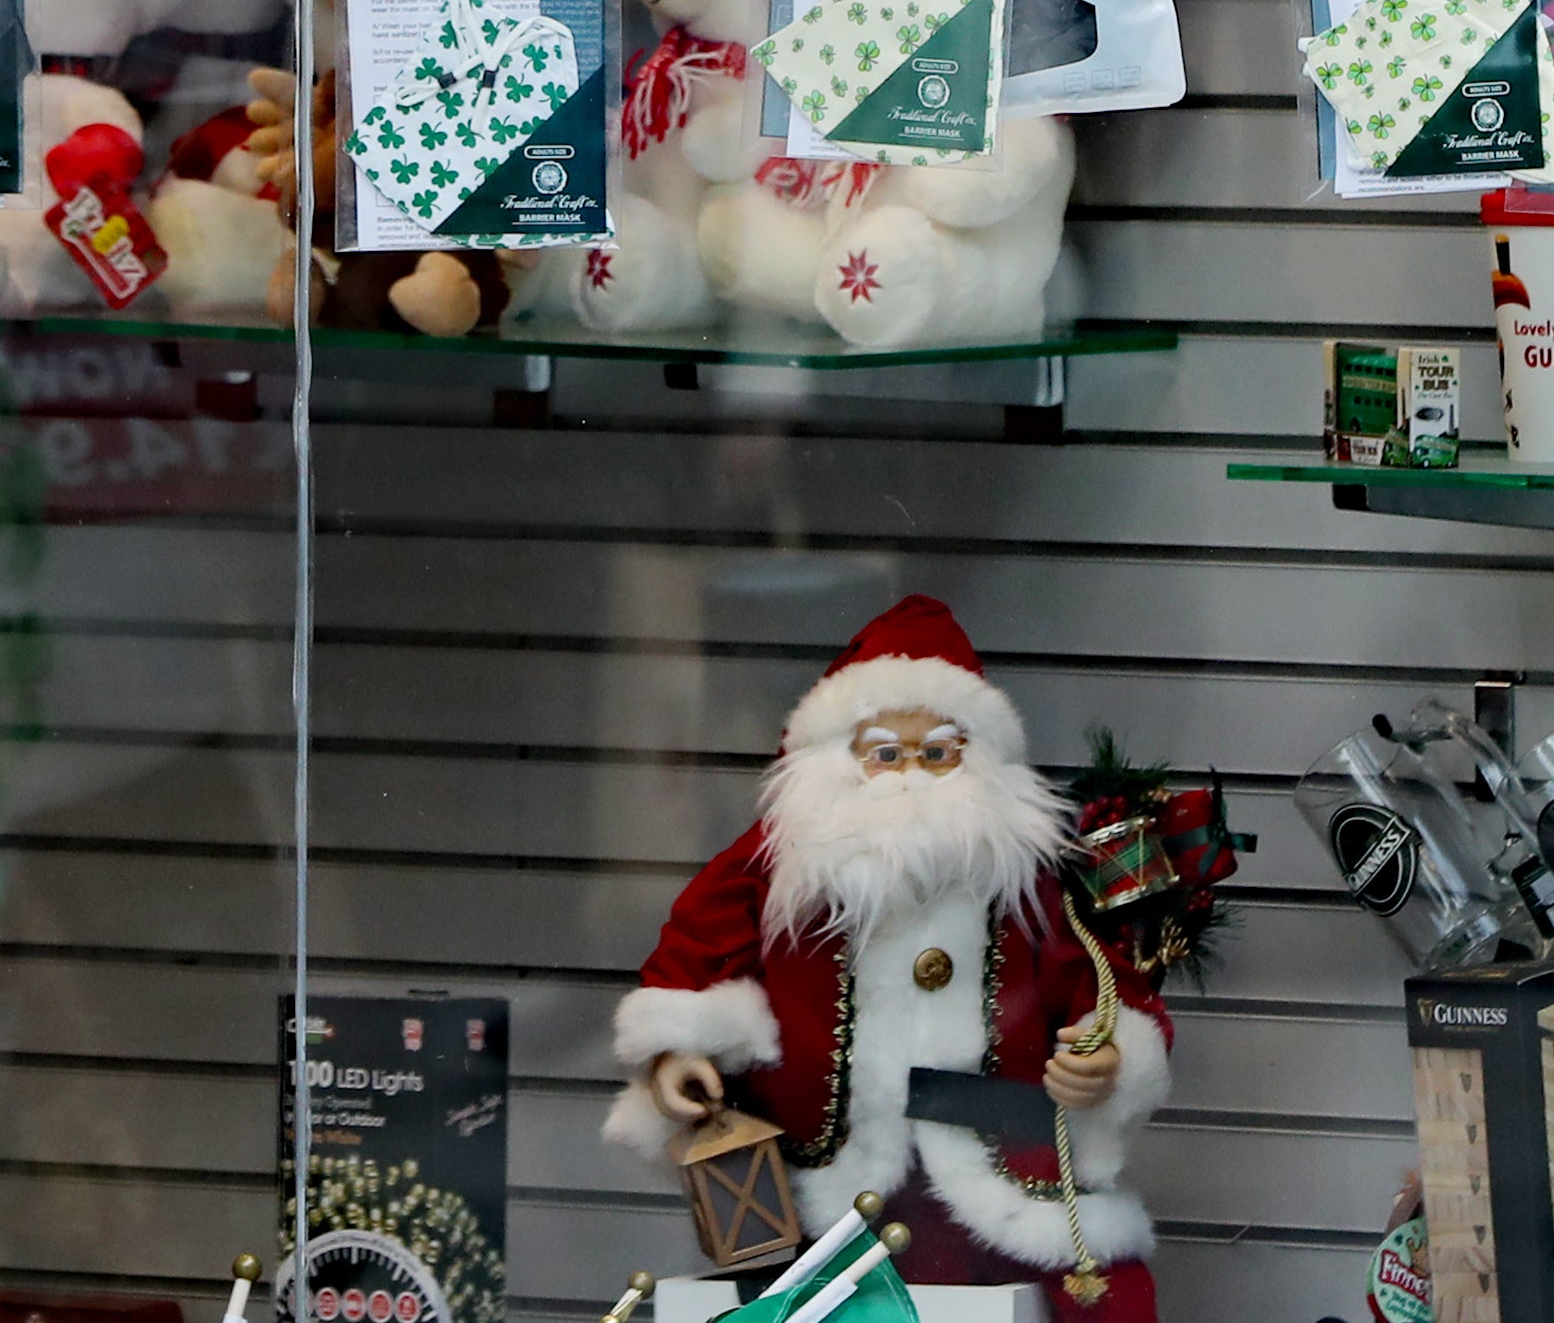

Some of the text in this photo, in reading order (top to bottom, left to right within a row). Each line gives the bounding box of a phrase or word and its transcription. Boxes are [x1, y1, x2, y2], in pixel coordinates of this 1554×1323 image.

[887, 106, 937, 124] Traditional
[940, 109, 965, 127] Craft
[904, 126, 962, 138] BARRIER MASK
[1442, 133, 1494, 149] Traditional
[1497, 131, 1522, 149] Craft
[1461, 150, 1520, 161] BARRIER MASK
[500, 194, 556, 209] Traditional
[560, 194, 587, 212] Craft
[519, 214, 582, 222] BARRIER MASK
[1418, 354, 1440, 365] Irish
[1417, 366, 1455, 378] TOUR
[1422, 379, 1450, 391] BUS
[1433, 1003, 1509, 1026] GUINNESS
[337, 1067, 369, 1089] LED
[372, 1069, 425, 1096] Lights
[339, 1112, 387, 1127] Outdoor
